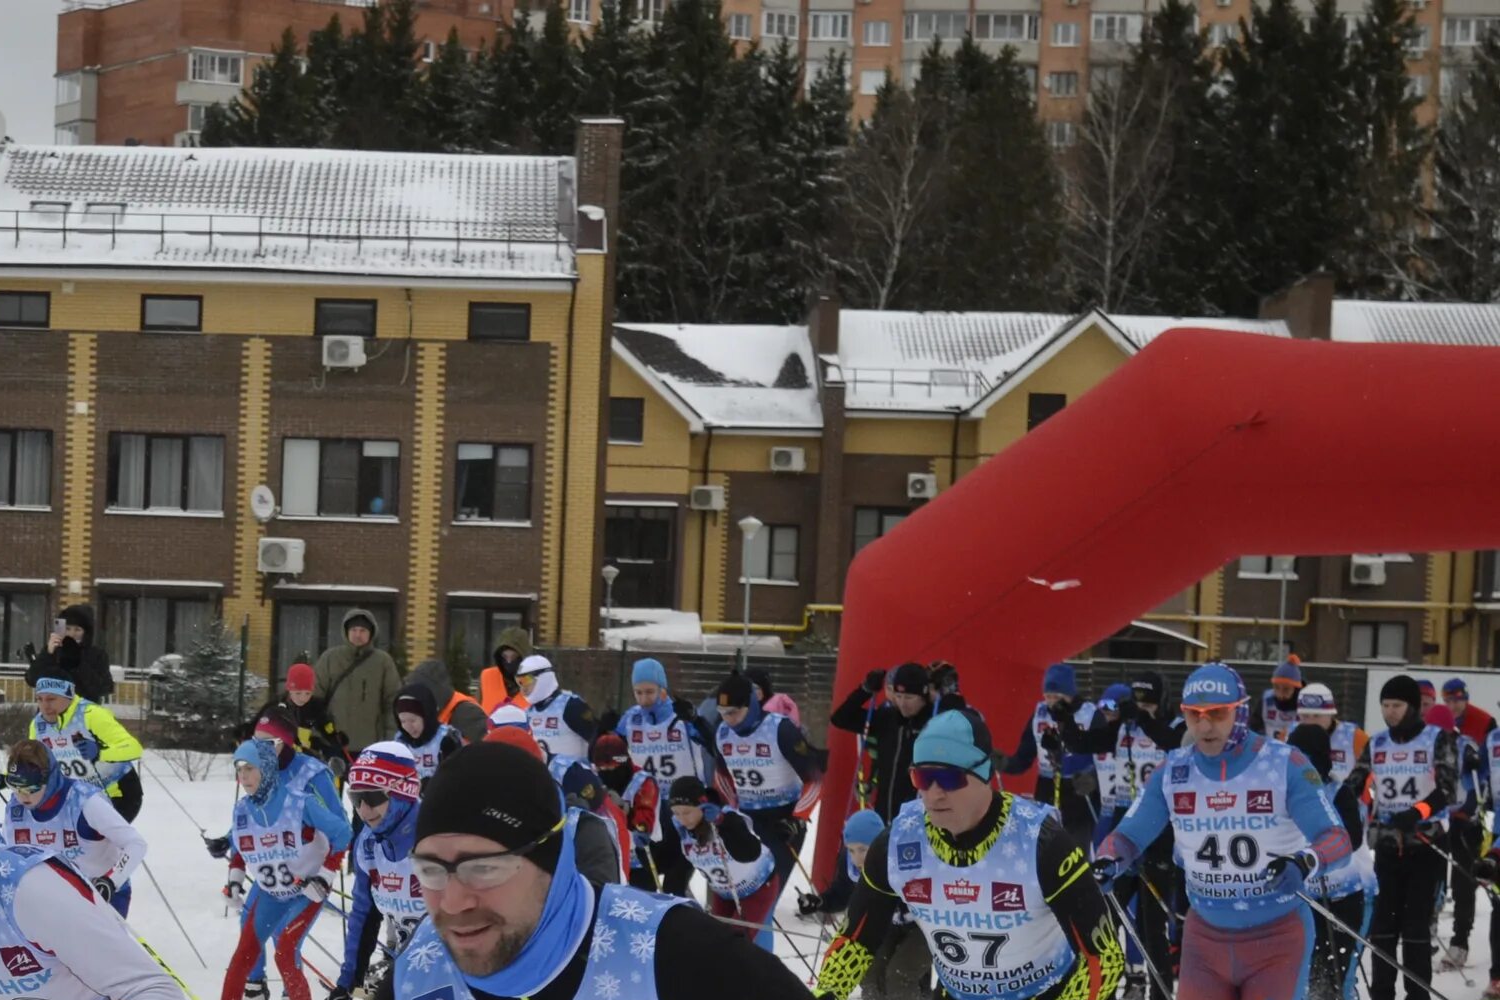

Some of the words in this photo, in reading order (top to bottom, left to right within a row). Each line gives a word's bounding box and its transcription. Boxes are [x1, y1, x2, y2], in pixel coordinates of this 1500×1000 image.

[643, 754, 677, 778] 45
[733, 769, 764, 788] 59
[1381, 776, 1420, 800] 34
[1195, 833, 1260, 870] 40
[257, 863, 295, 889] 33
[931, 928, 1010, 969] 67
[996, 961, 1057, 994] ГОНОК
